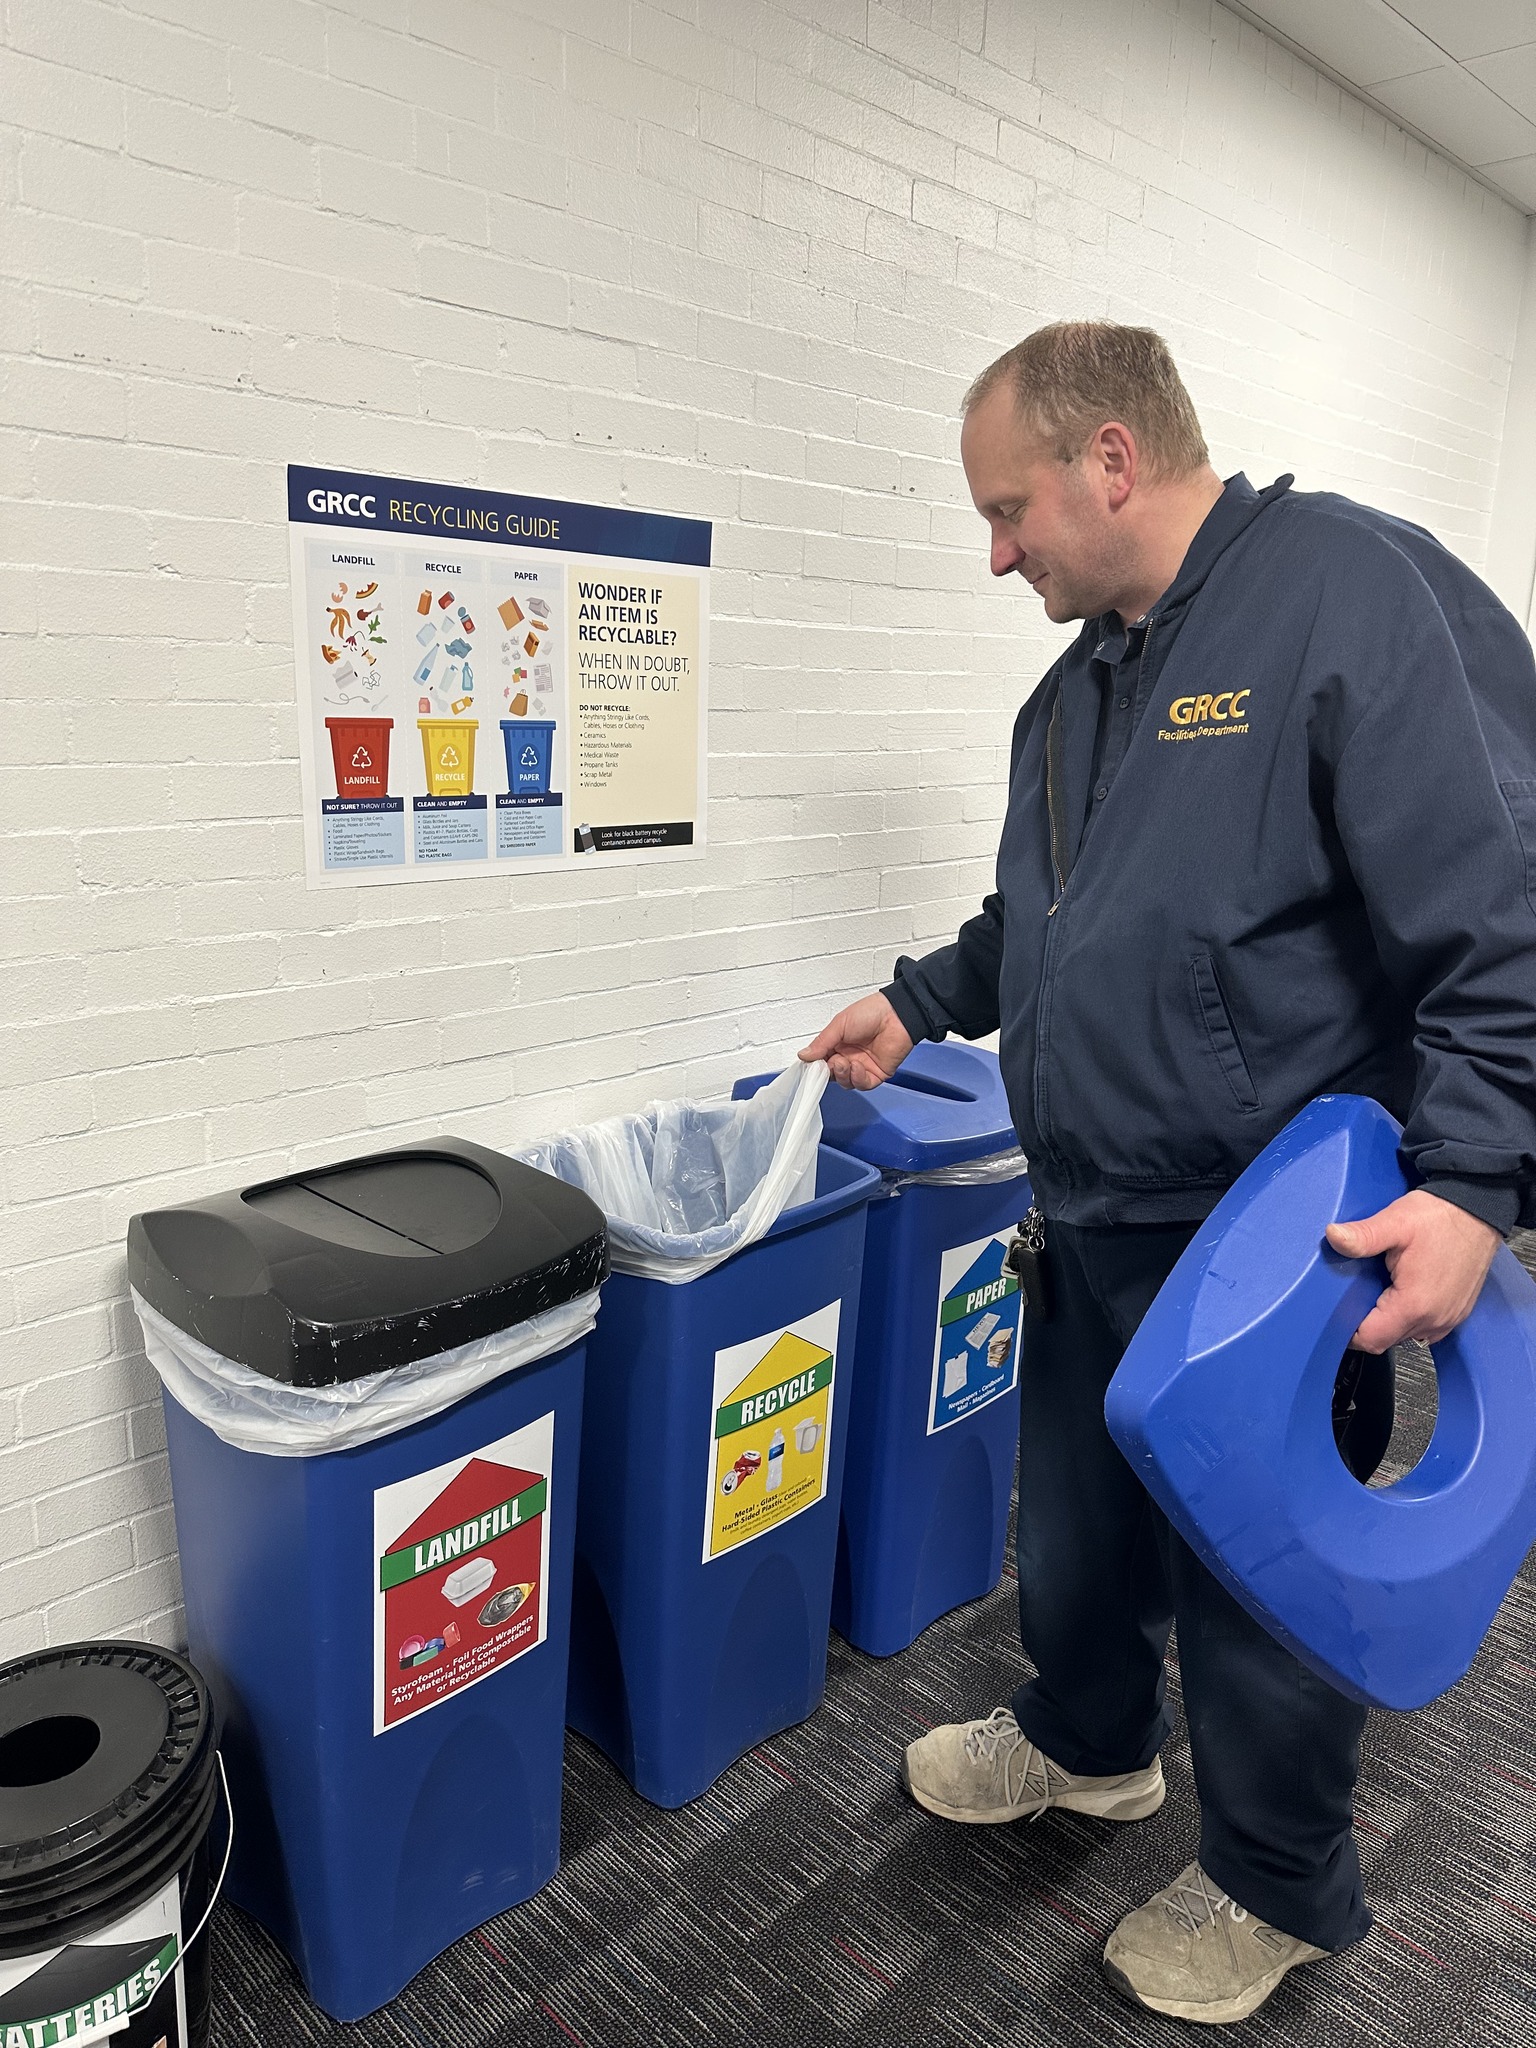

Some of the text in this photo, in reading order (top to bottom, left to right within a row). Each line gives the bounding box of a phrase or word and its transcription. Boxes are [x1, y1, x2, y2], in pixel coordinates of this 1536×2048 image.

[307, 489, 560, 540] GRCC RECYCLING GUIDE
[332, 554, 375, 566] LANDFILL
[425, 563, 461, 574] RECYCLE
[514, 571, 538, 581] PAPER
[578, 582, 662, 604] WONDER IF
[578, 604, 658, 624] AN ITEM IS
[579, 625, 676, 646] RECYCLABLE?
[578, 652, 690, 675] WHEN IN DOUBT,
[579, 673, 679, 691] THROW IT OUT.
[1169, 689, 1251, 725] GRCC
[1158, 723, 1249, 741] Facilities Department
[344, 776, 380, 785] LANDFILL
[435, 773, 465, 781] RECYCLE
[966, 1277, 1006, 1313] PAPER
[741, 1369, 816, 1426] RECYCLE
[722, 1509, 760, 1532] Hard-Sided
[762, 1498, 782, 1513] Plastic
[784, 1479, 815, 1500] Containers
[735, 1494, 778, 1518] Metal Glass
[415, 1498, 521, 1573] LANDFILL
[391, 1615, 534, 1697] Styrofoam Foil Food Wrappers
[394, 1625, 531, 1706] Any Material Not Compostable
[437, 1656, 496, 1693] or Recyclable
